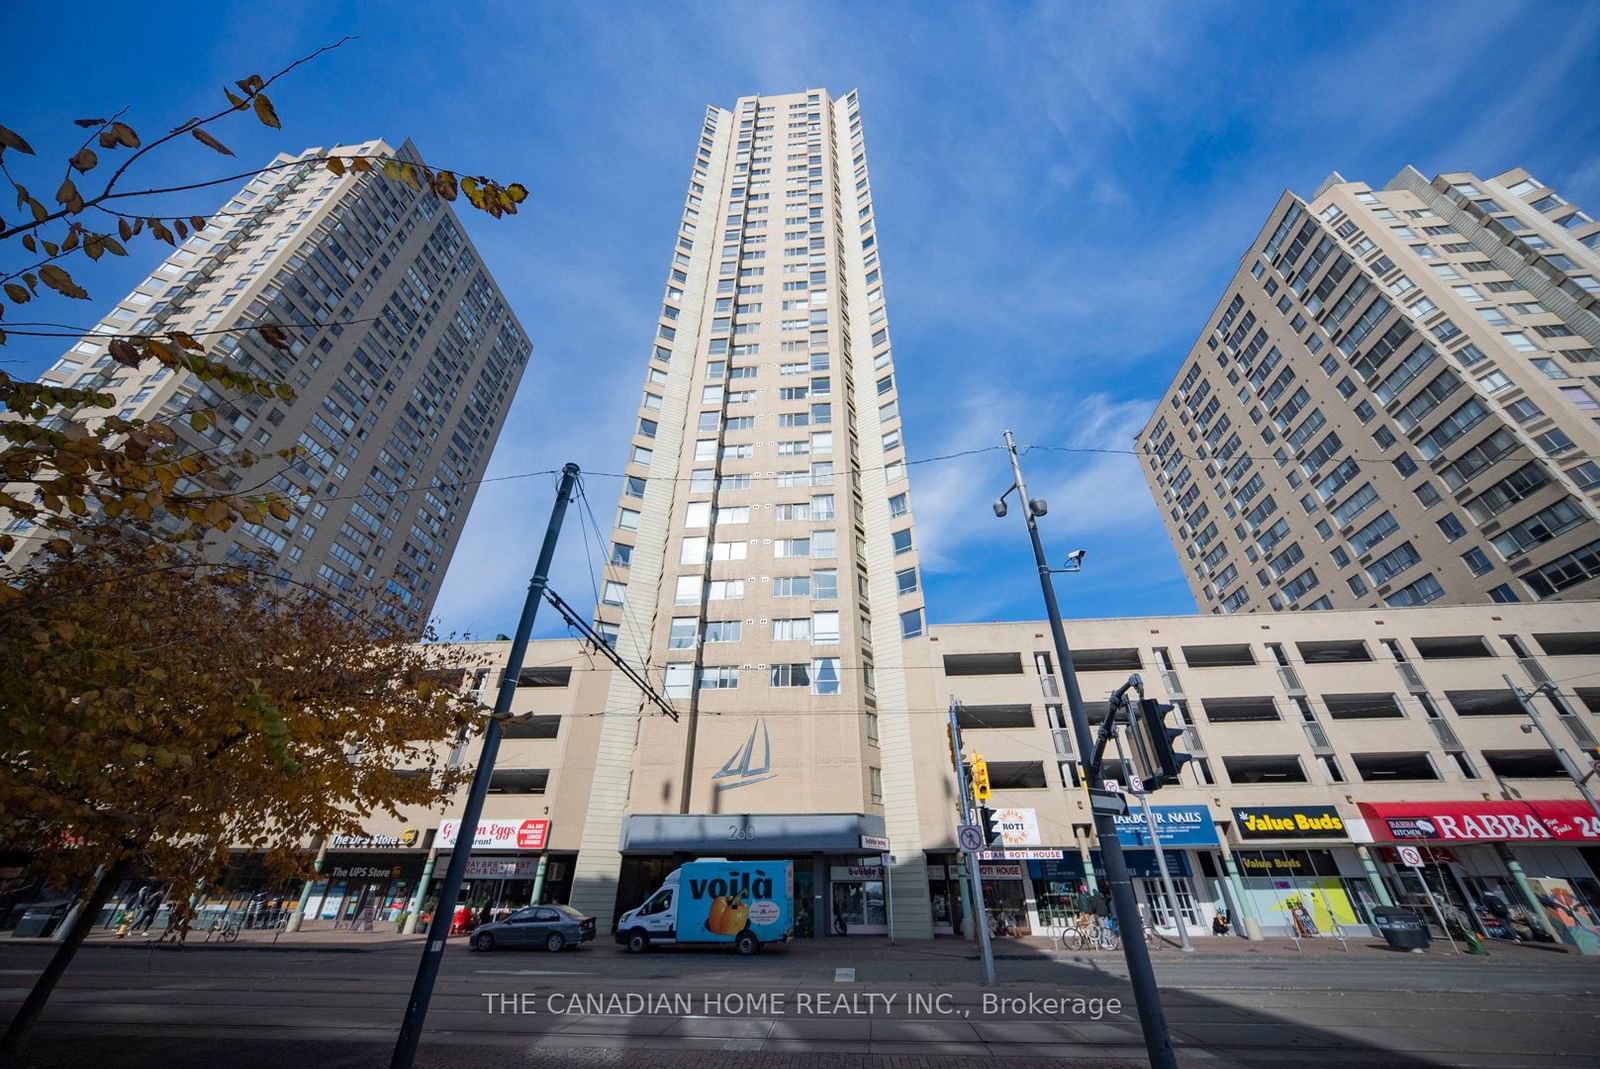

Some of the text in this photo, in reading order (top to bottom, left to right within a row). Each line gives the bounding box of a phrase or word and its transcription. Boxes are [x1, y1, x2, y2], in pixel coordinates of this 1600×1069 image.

[1167, 812, 1202, 823] NAILS
[1245, 813, 1342, 831] Value Buds
[490, 823, 516, 841] Eggs
[727, 824, 757, 841] 260
[1002, 823, 1024, 831] ROTI
[1433, 815, 1552, 839] RABBA
[333, 833, 351, 845] The
[371, 833, 399, 845] Store
[1009, 851, 1029, 859] ROTI
[1243, 858, 1301, 868] Value Buds
[333, 866, 390, 877] The UPS Store
[997, 866, 1020, 876] HOUSE
[689, 869, 773, 900] voilà
